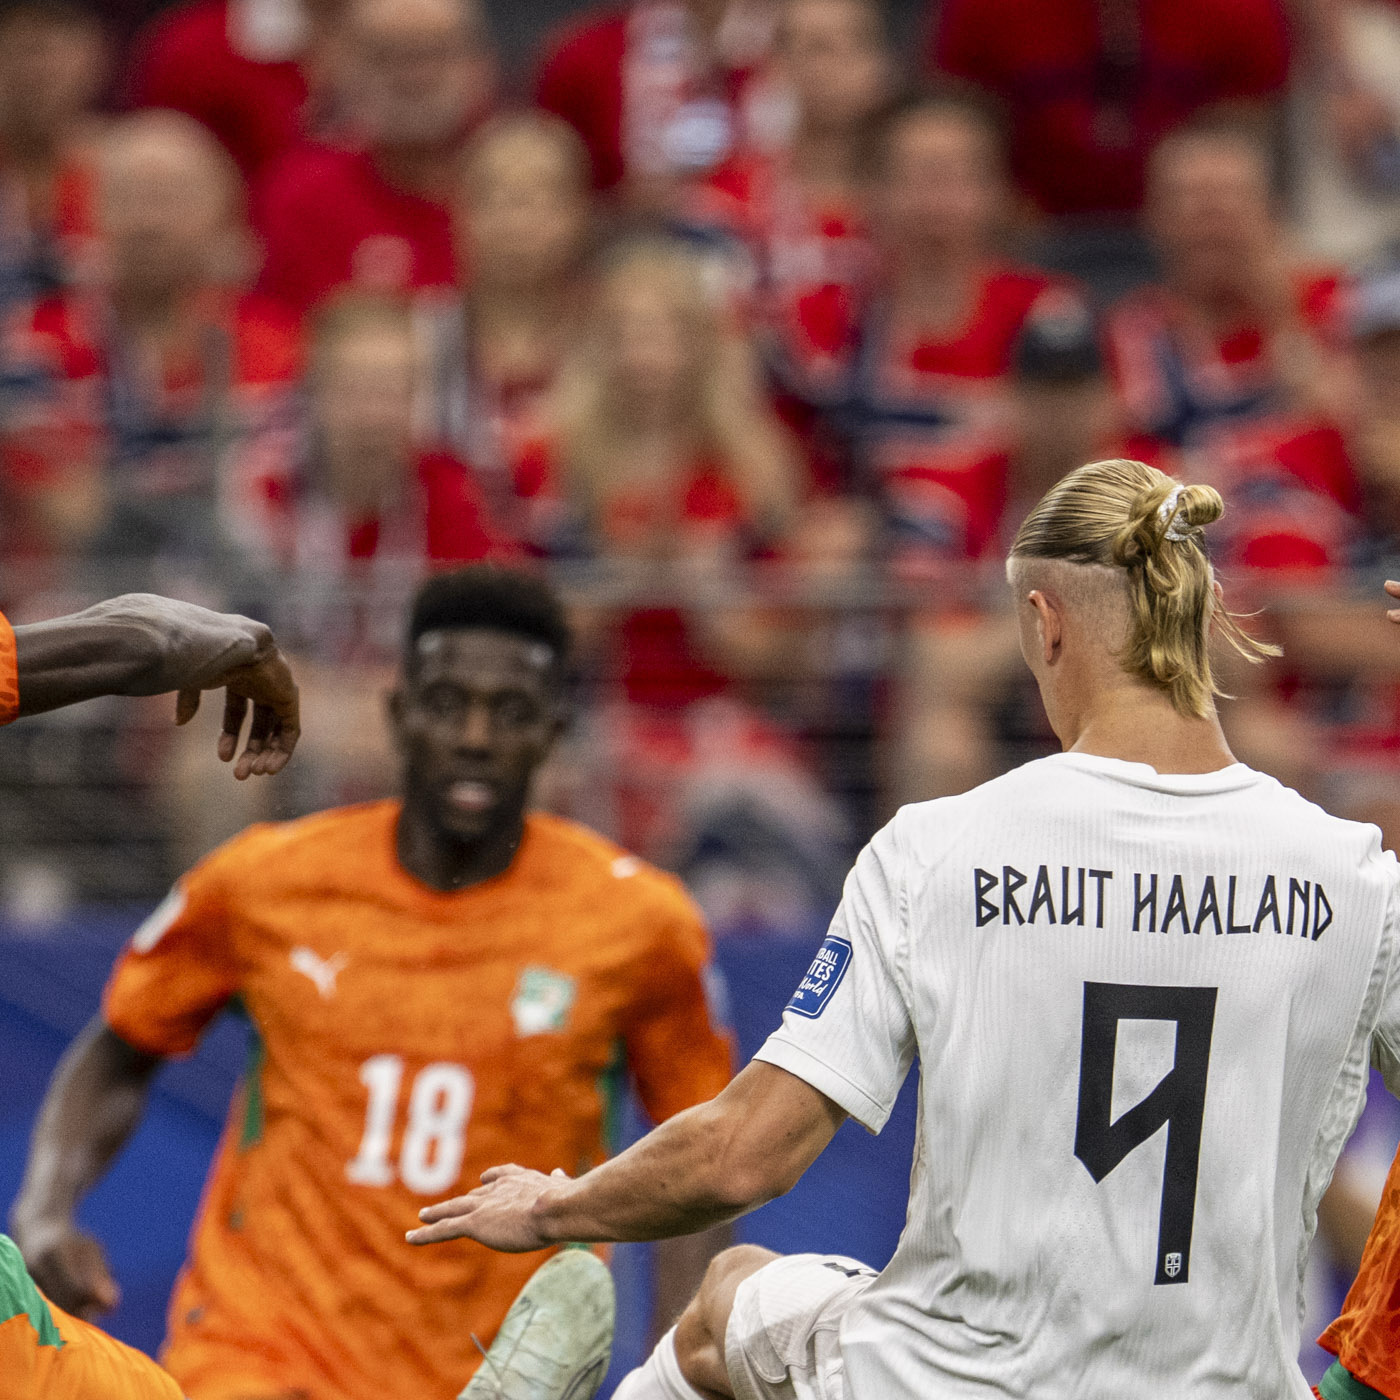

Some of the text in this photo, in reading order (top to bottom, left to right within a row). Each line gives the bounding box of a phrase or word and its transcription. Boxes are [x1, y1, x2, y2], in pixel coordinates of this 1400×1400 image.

[974, 865, 1333, 942] BRAUT HAALAND
[343, 1053, 476, 1194] 18
[1074, 981, 1218, 1285] 9
